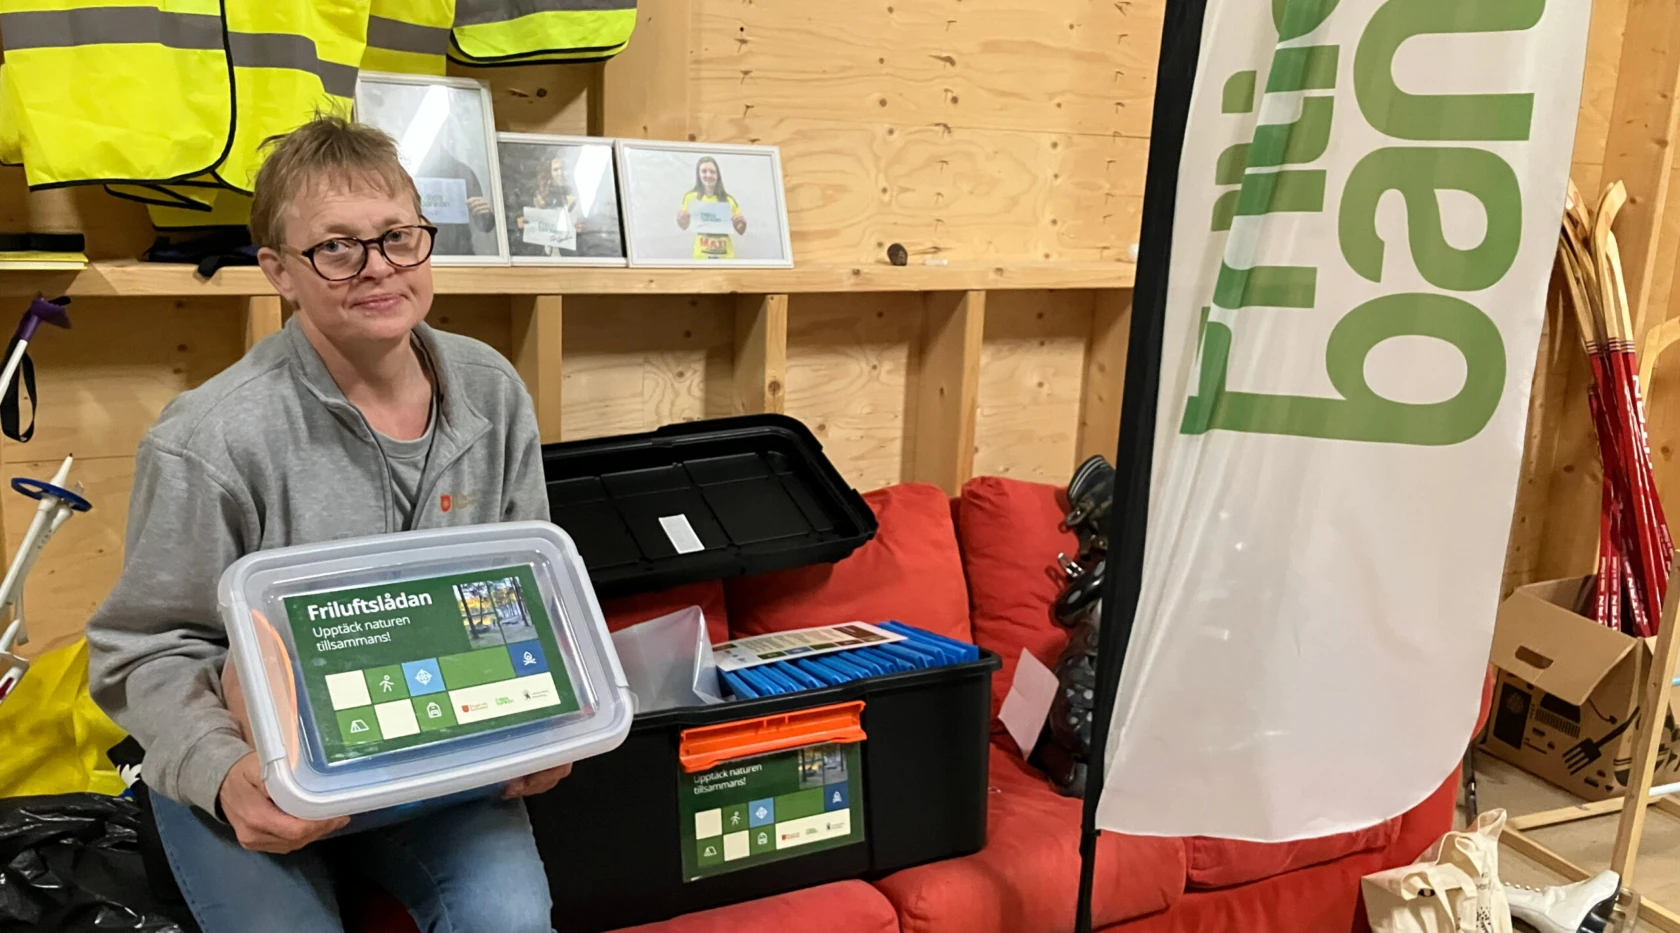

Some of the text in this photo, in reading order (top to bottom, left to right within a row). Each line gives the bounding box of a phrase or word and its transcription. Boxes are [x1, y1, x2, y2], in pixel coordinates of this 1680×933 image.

[307, 592, 433, 621] Friluftslådan
[312, 616, 411, 639] Upptäck naturen
[316, 632, 391, 652] tillsammans!
[730, 764, 762, 776] naturen
[693, 777, 746, 795] tillsammans!
